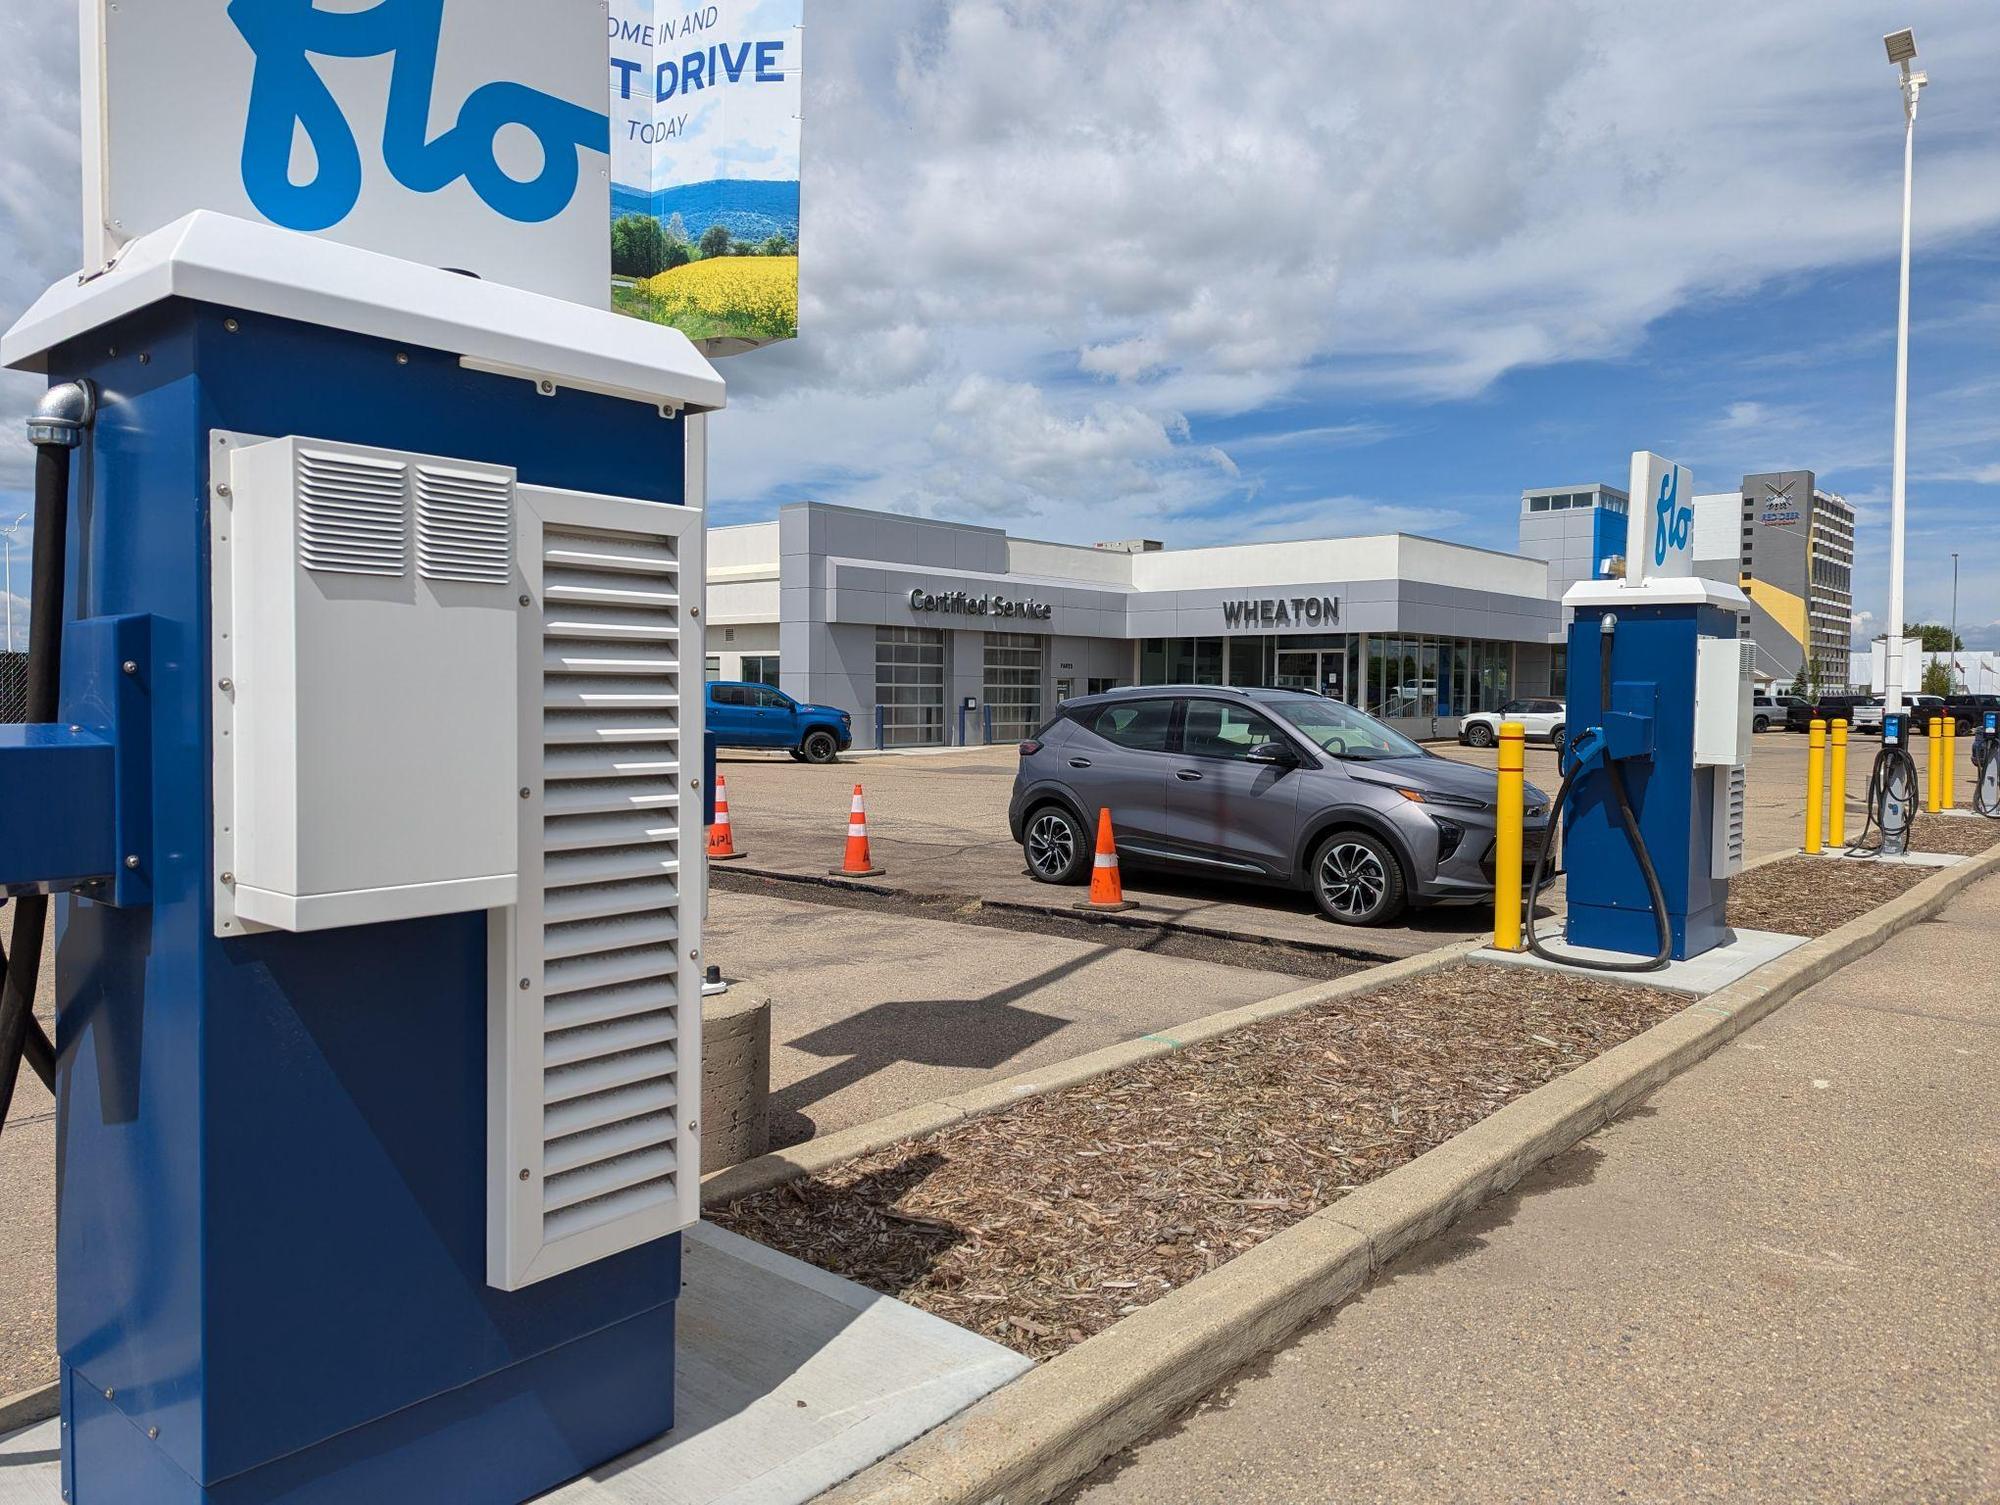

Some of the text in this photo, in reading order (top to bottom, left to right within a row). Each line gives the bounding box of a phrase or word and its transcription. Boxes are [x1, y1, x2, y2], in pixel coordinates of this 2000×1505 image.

[659, 20, 675, 44] IN
[680, 6, 717, 37] AND
[656, 41, 784, 103] DRIVE
[627, 113, 688, 144] TODAY
[1655, 464, 1692, 566] flo
[909, 588, 1052, 619] Certified Service
[1222, 597, 1340, 622] WHEATON
